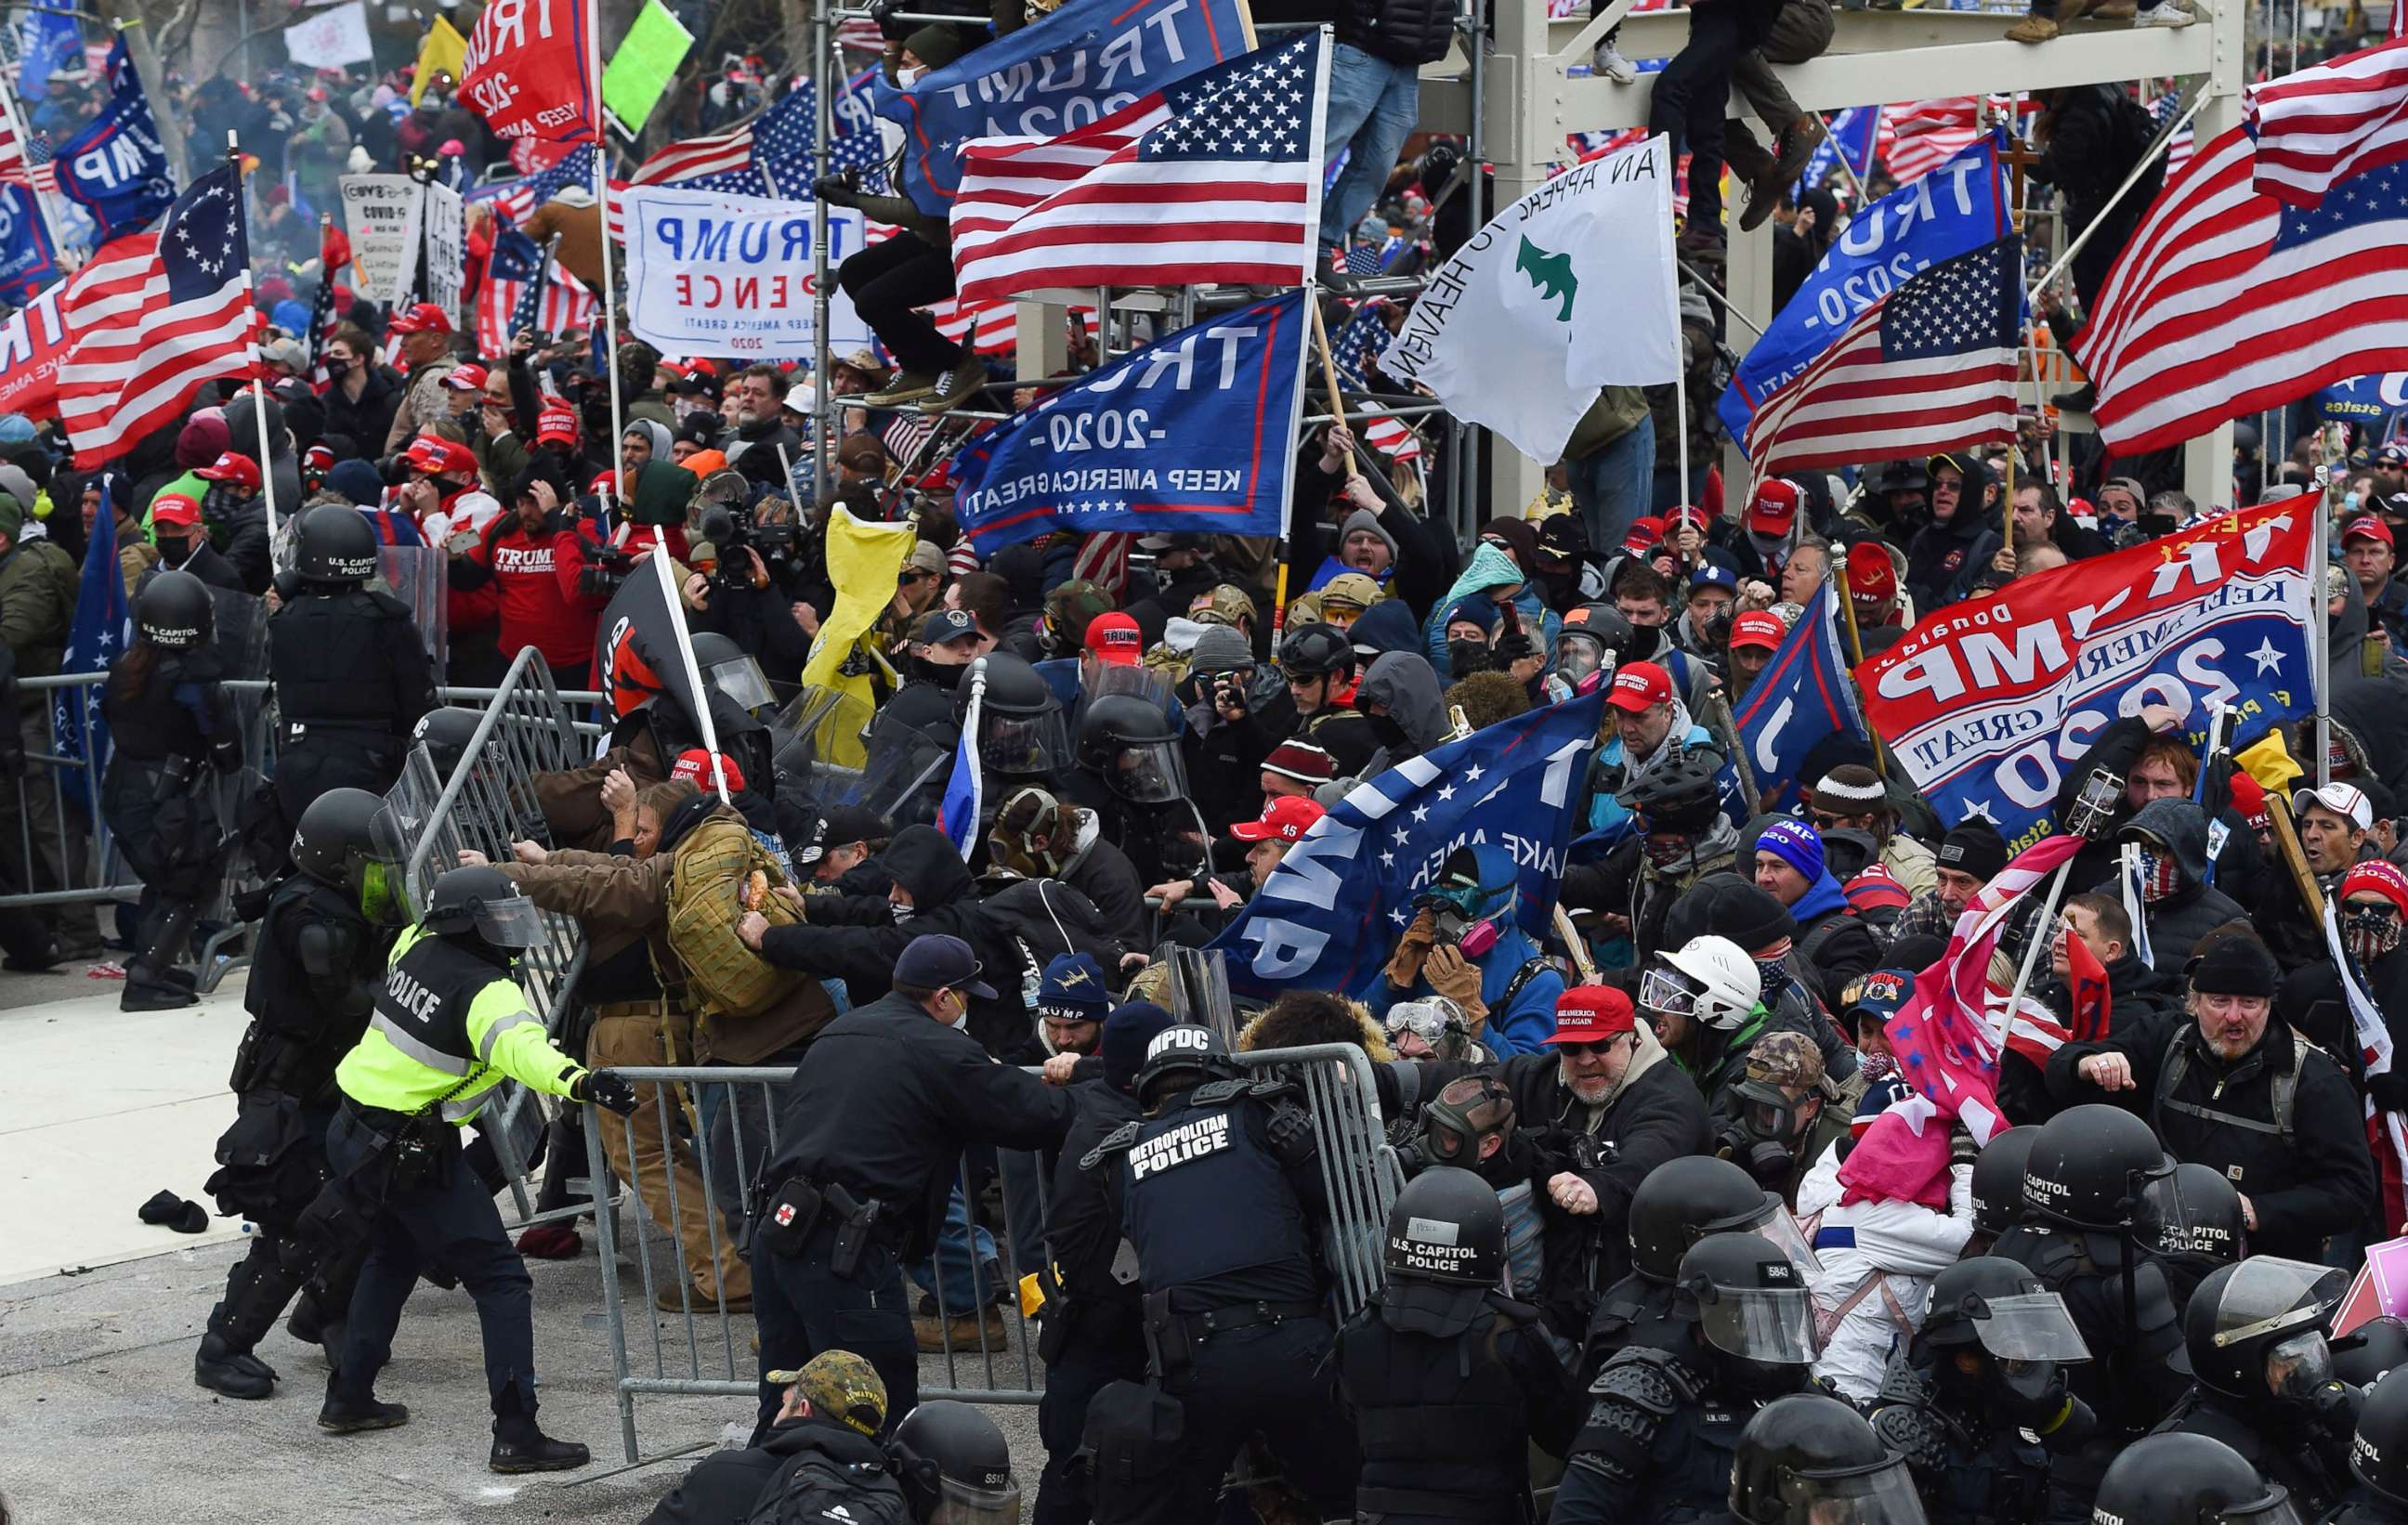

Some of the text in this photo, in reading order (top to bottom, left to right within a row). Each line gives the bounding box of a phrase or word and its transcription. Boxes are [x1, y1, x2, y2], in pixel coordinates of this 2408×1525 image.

[329, 557, 376, 567] U.S. CAPITO
[341, 567, 372, 575] POLICE
[1852, 592, 1878, 603] UMP
[159, 627, 199, 637] CAPITOL
[152, 634, 186, 645] POLICE
[1282, 823, 1298, 837] 45
[386, 965, 441, 1023] POLICE
[1039, 1007, 1085, 1020] TRUMP
[1147, 1028, 1209, 1062] MPDC
[1129, 1114, 1229, 1166] METROPOLITAN
[1133, 1129, 1229, 1180] POLICE
[2026, 1175, 2072, 1197] CAPITOL
[1392, 1236, 1478, 1258] U.S. CAPITOL
[1407, 1254, 1459, 1271] POLICE
[1768, 1265, 1789, 1278] 5843
